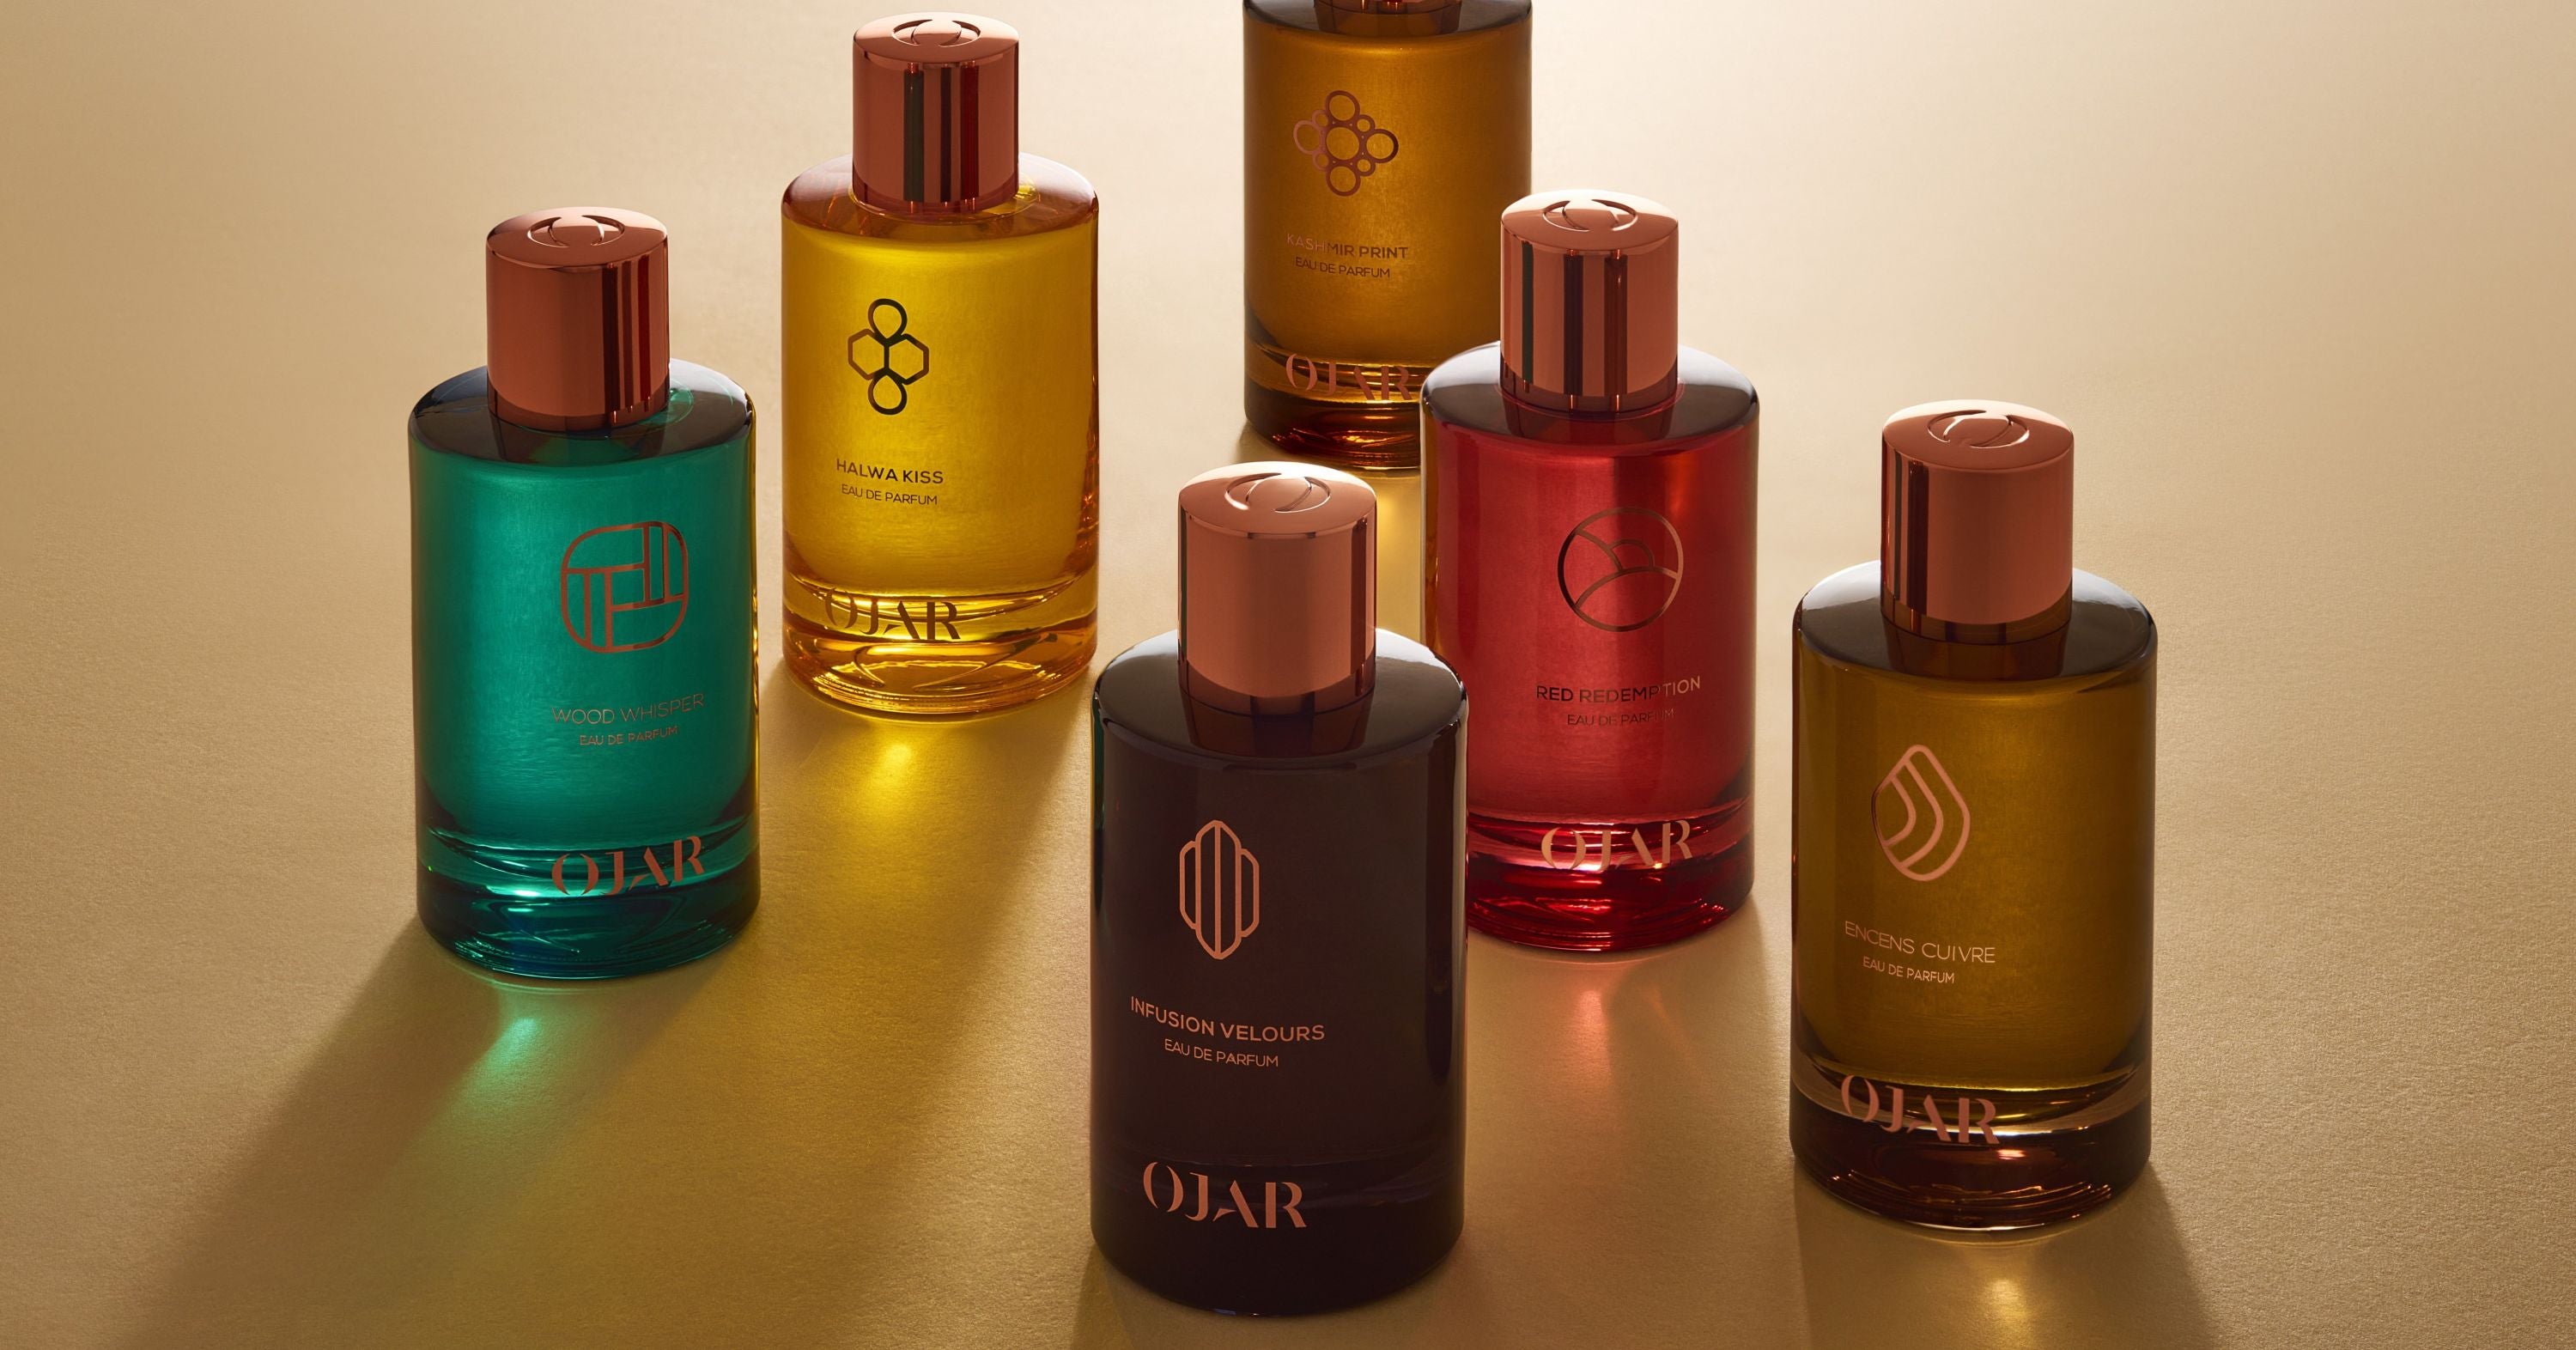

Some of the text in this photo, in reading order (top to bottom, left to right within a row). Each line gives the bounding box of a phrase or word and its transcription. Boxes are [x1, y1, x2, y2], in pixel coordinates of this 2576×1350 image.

[1287, 233, 1408, 259] KASHMIR PRINT
[1295, 257, 1390, 278] EAU DE PARFUM
[1285, 353, 1412, 401] OJAR
[836, 458, 944, 484] HALWA KISS
[841, 483, 938, 506] EAU DE PARFUM
[824, 587, 961, 641] OJAR
[1536, 676, 1700, 703] RED REDEMPTION
[551, 693, 705, 725] WOOD WHISPER
[1567, 708, 1674, 727] EAU DE PARFUM
[580, 725, 679, 746] EAU DE PARFUM
[1540, 819, 1692, 873] OJAR
[551, 835, 705, 896] OJAR
[1845, 921, 1996, 964] ENCENS CUIVRE
[1862, 956, 1955, 983] EAU DE PARFUM
[1130, 995, 1326, 1043] INFUSION VELOURS
[1164, 1038, 1279, 1067] EAU DE PARFUM
[1841, 1074, 2000, 1145] OJAR
[1143, 1161, 1307, 1228] OJAR
